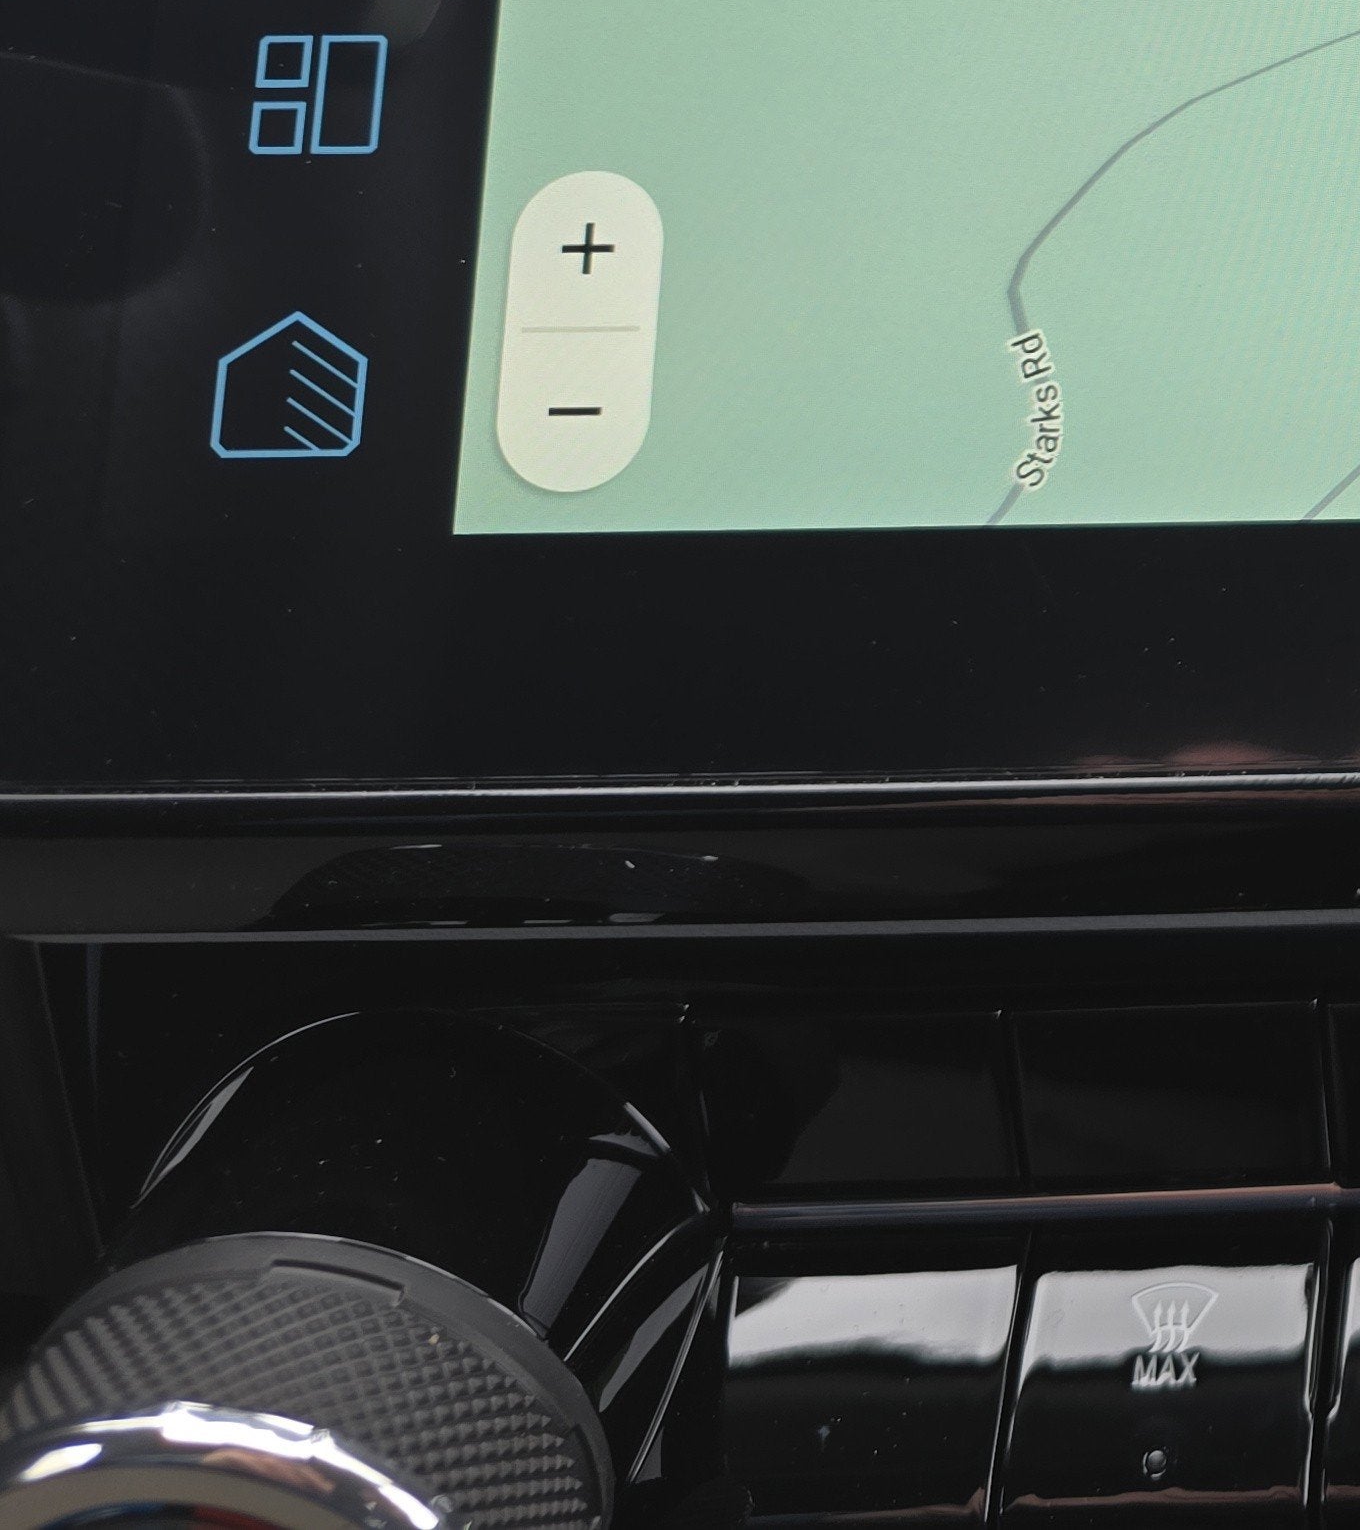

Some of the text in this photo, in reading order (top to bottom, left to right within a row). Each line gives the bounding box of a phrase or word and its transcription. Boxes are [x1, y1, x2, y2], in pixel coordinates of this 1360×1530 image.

[1010, 332, 1061, 487] Starks Rd
[1131, 1351, 1200, 1388] MAX
